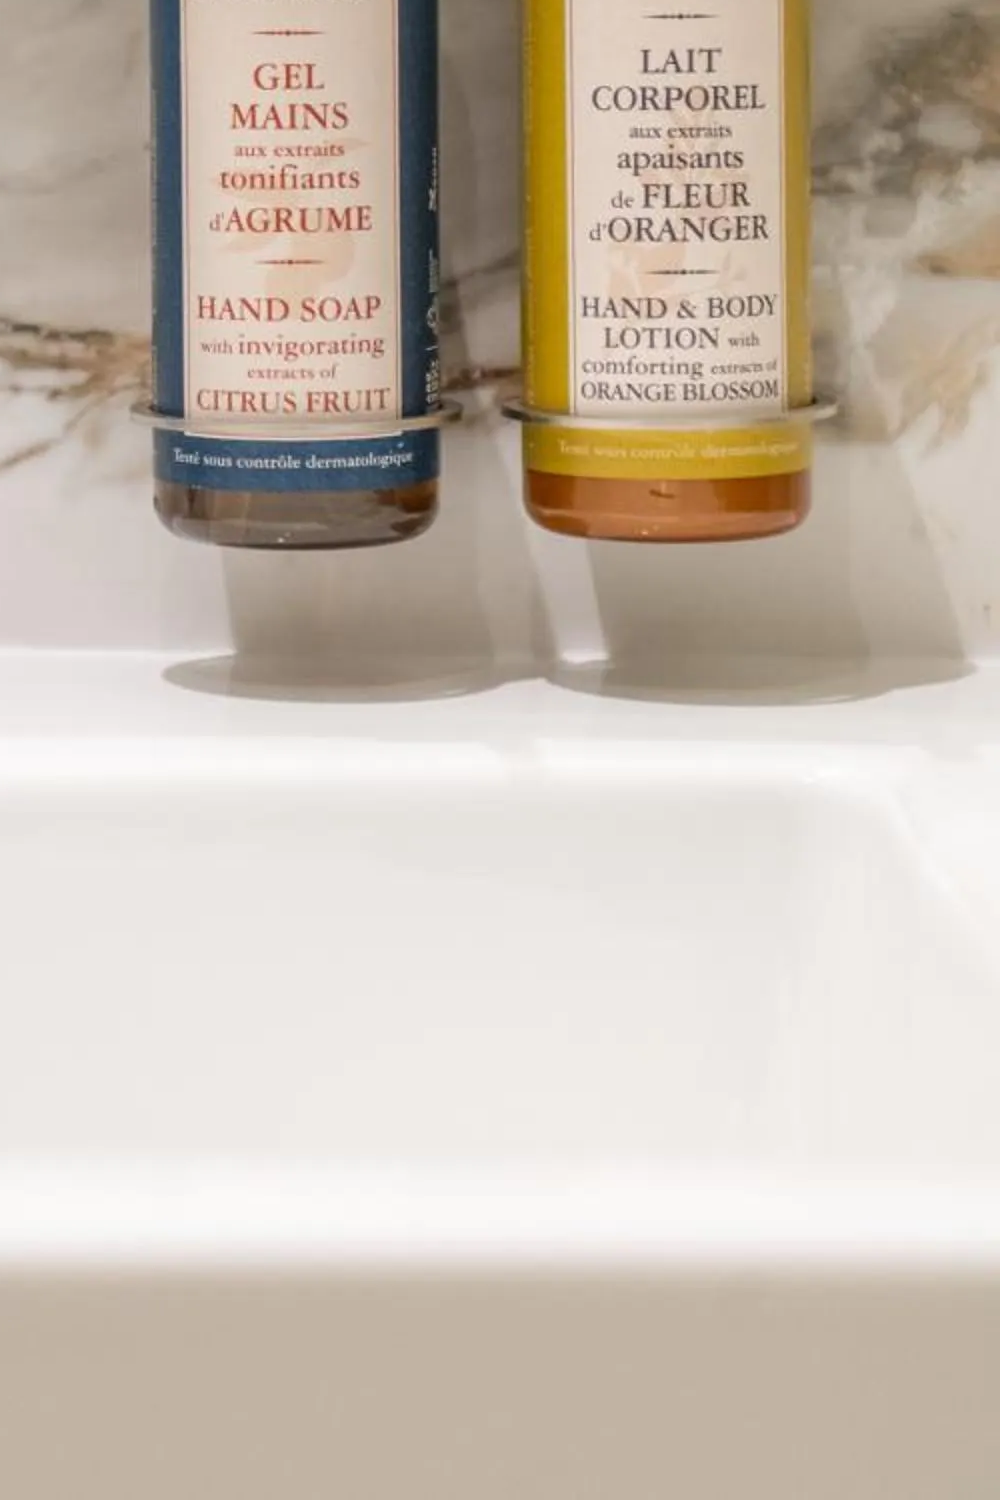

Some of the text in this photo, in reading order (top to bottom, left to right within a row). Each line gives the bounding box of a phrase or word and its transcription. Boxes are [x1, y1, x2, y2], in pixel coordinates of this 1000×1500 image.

[640, 48, 722, 74] LAIT
[253, 63, 325, 90] GEL
[591, 85, 765, 111] CORPOREL
[230, 103, 349, 129] MAINS
[628, 124, 733, 139] aux extraits
[234, 143, 345, 158] aux extraits
[617, 143, 745, 177] apaisants
[220, 163, 360, 190] tonifiants
[611, 182, 750, 209] de FLEUR
[209, 206, 372, 234] d'AGRUME
[589, 215, 769, 243] d'ORANGER
[197, 295, 381, 323] HAND SOAP
[581, 295, 779, 320] HAND & BODY
[200, 333, 385, 361] with invigorating
[604, 327, 760, 350] LOTION with
[247, 364, 338, 380] extracts of
[582, 356, 704, 380] comforting
[711, 360, 763, 374] extracts
[197, 388, 391, 414] CITRUS FRUIT
[581, 380, 779, 401] ORANGE BLOSSOM
